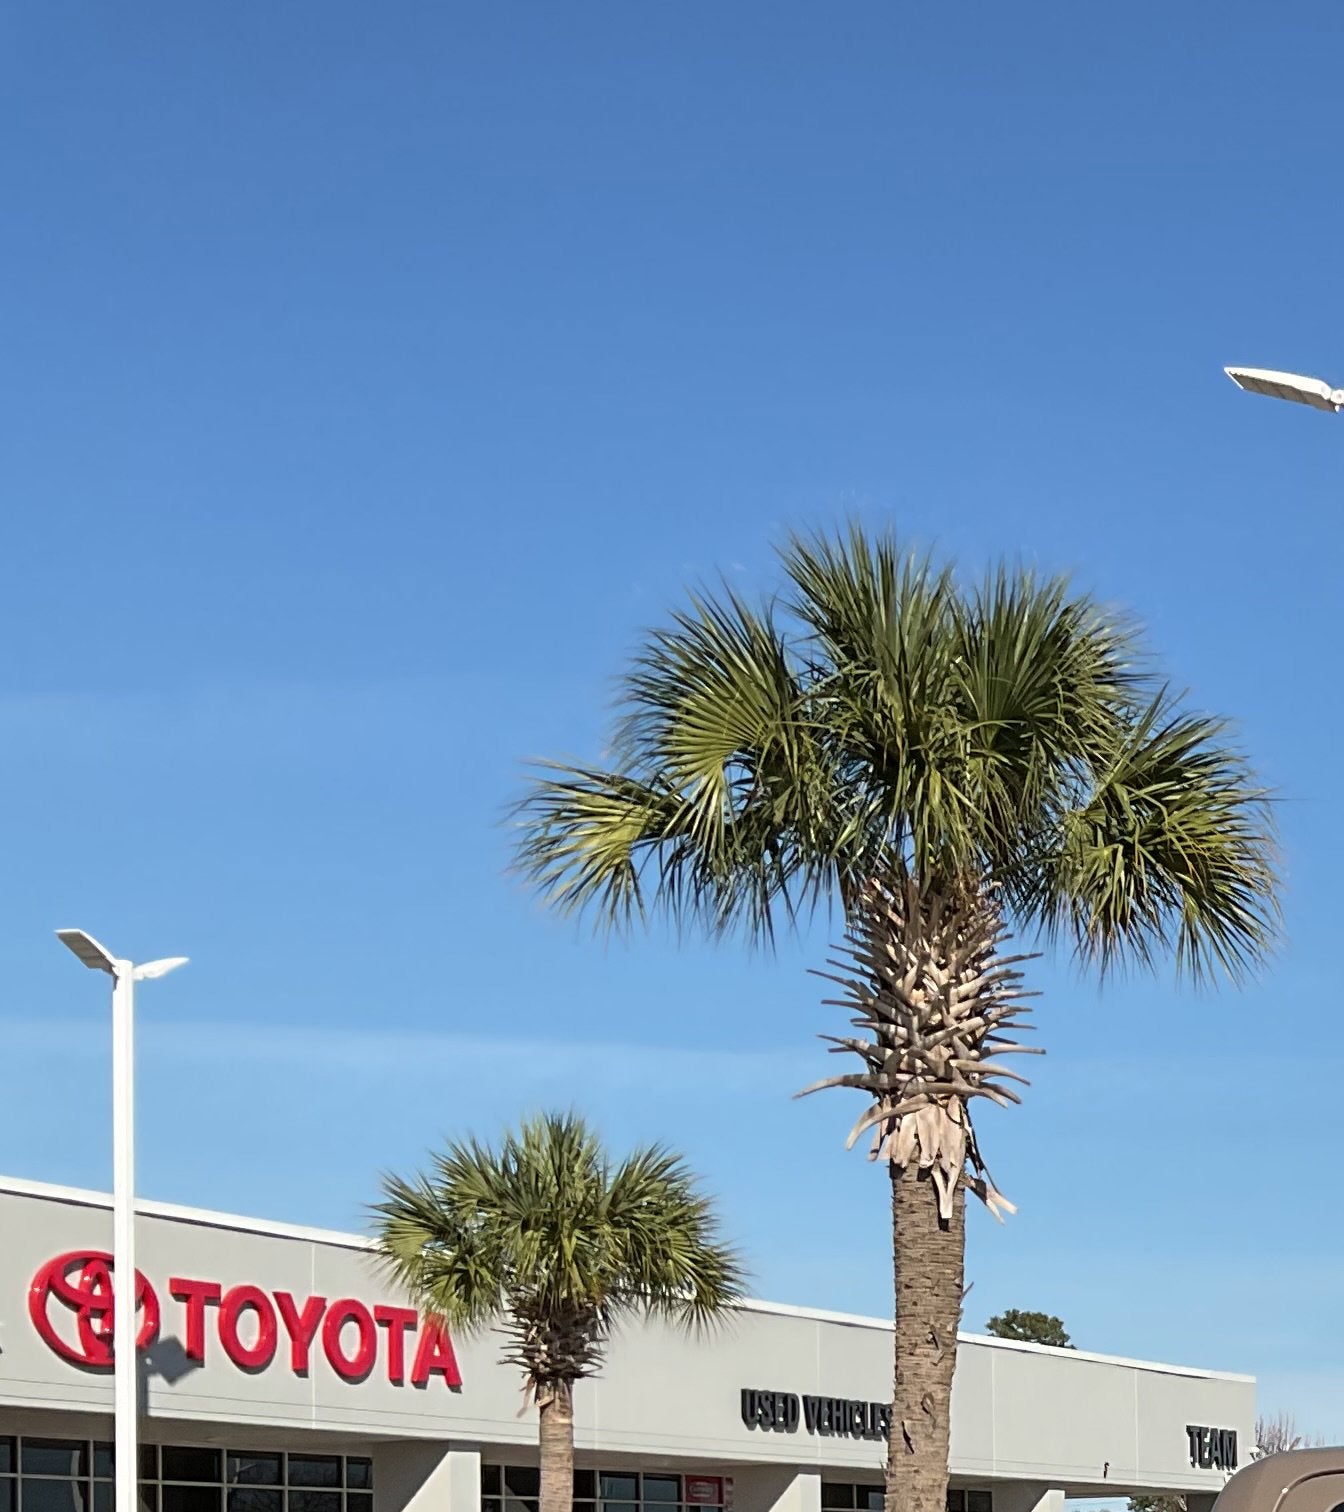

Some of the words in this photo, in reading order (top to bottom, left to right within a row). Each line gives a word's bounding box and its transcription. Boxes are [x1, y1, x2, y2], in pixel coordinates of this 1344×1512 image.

[169, 1277, 463, 1391] TOYOTA
[741, 1389, 800, 1432] USED
[1186, 1425, 1237, 1470] TEAM
